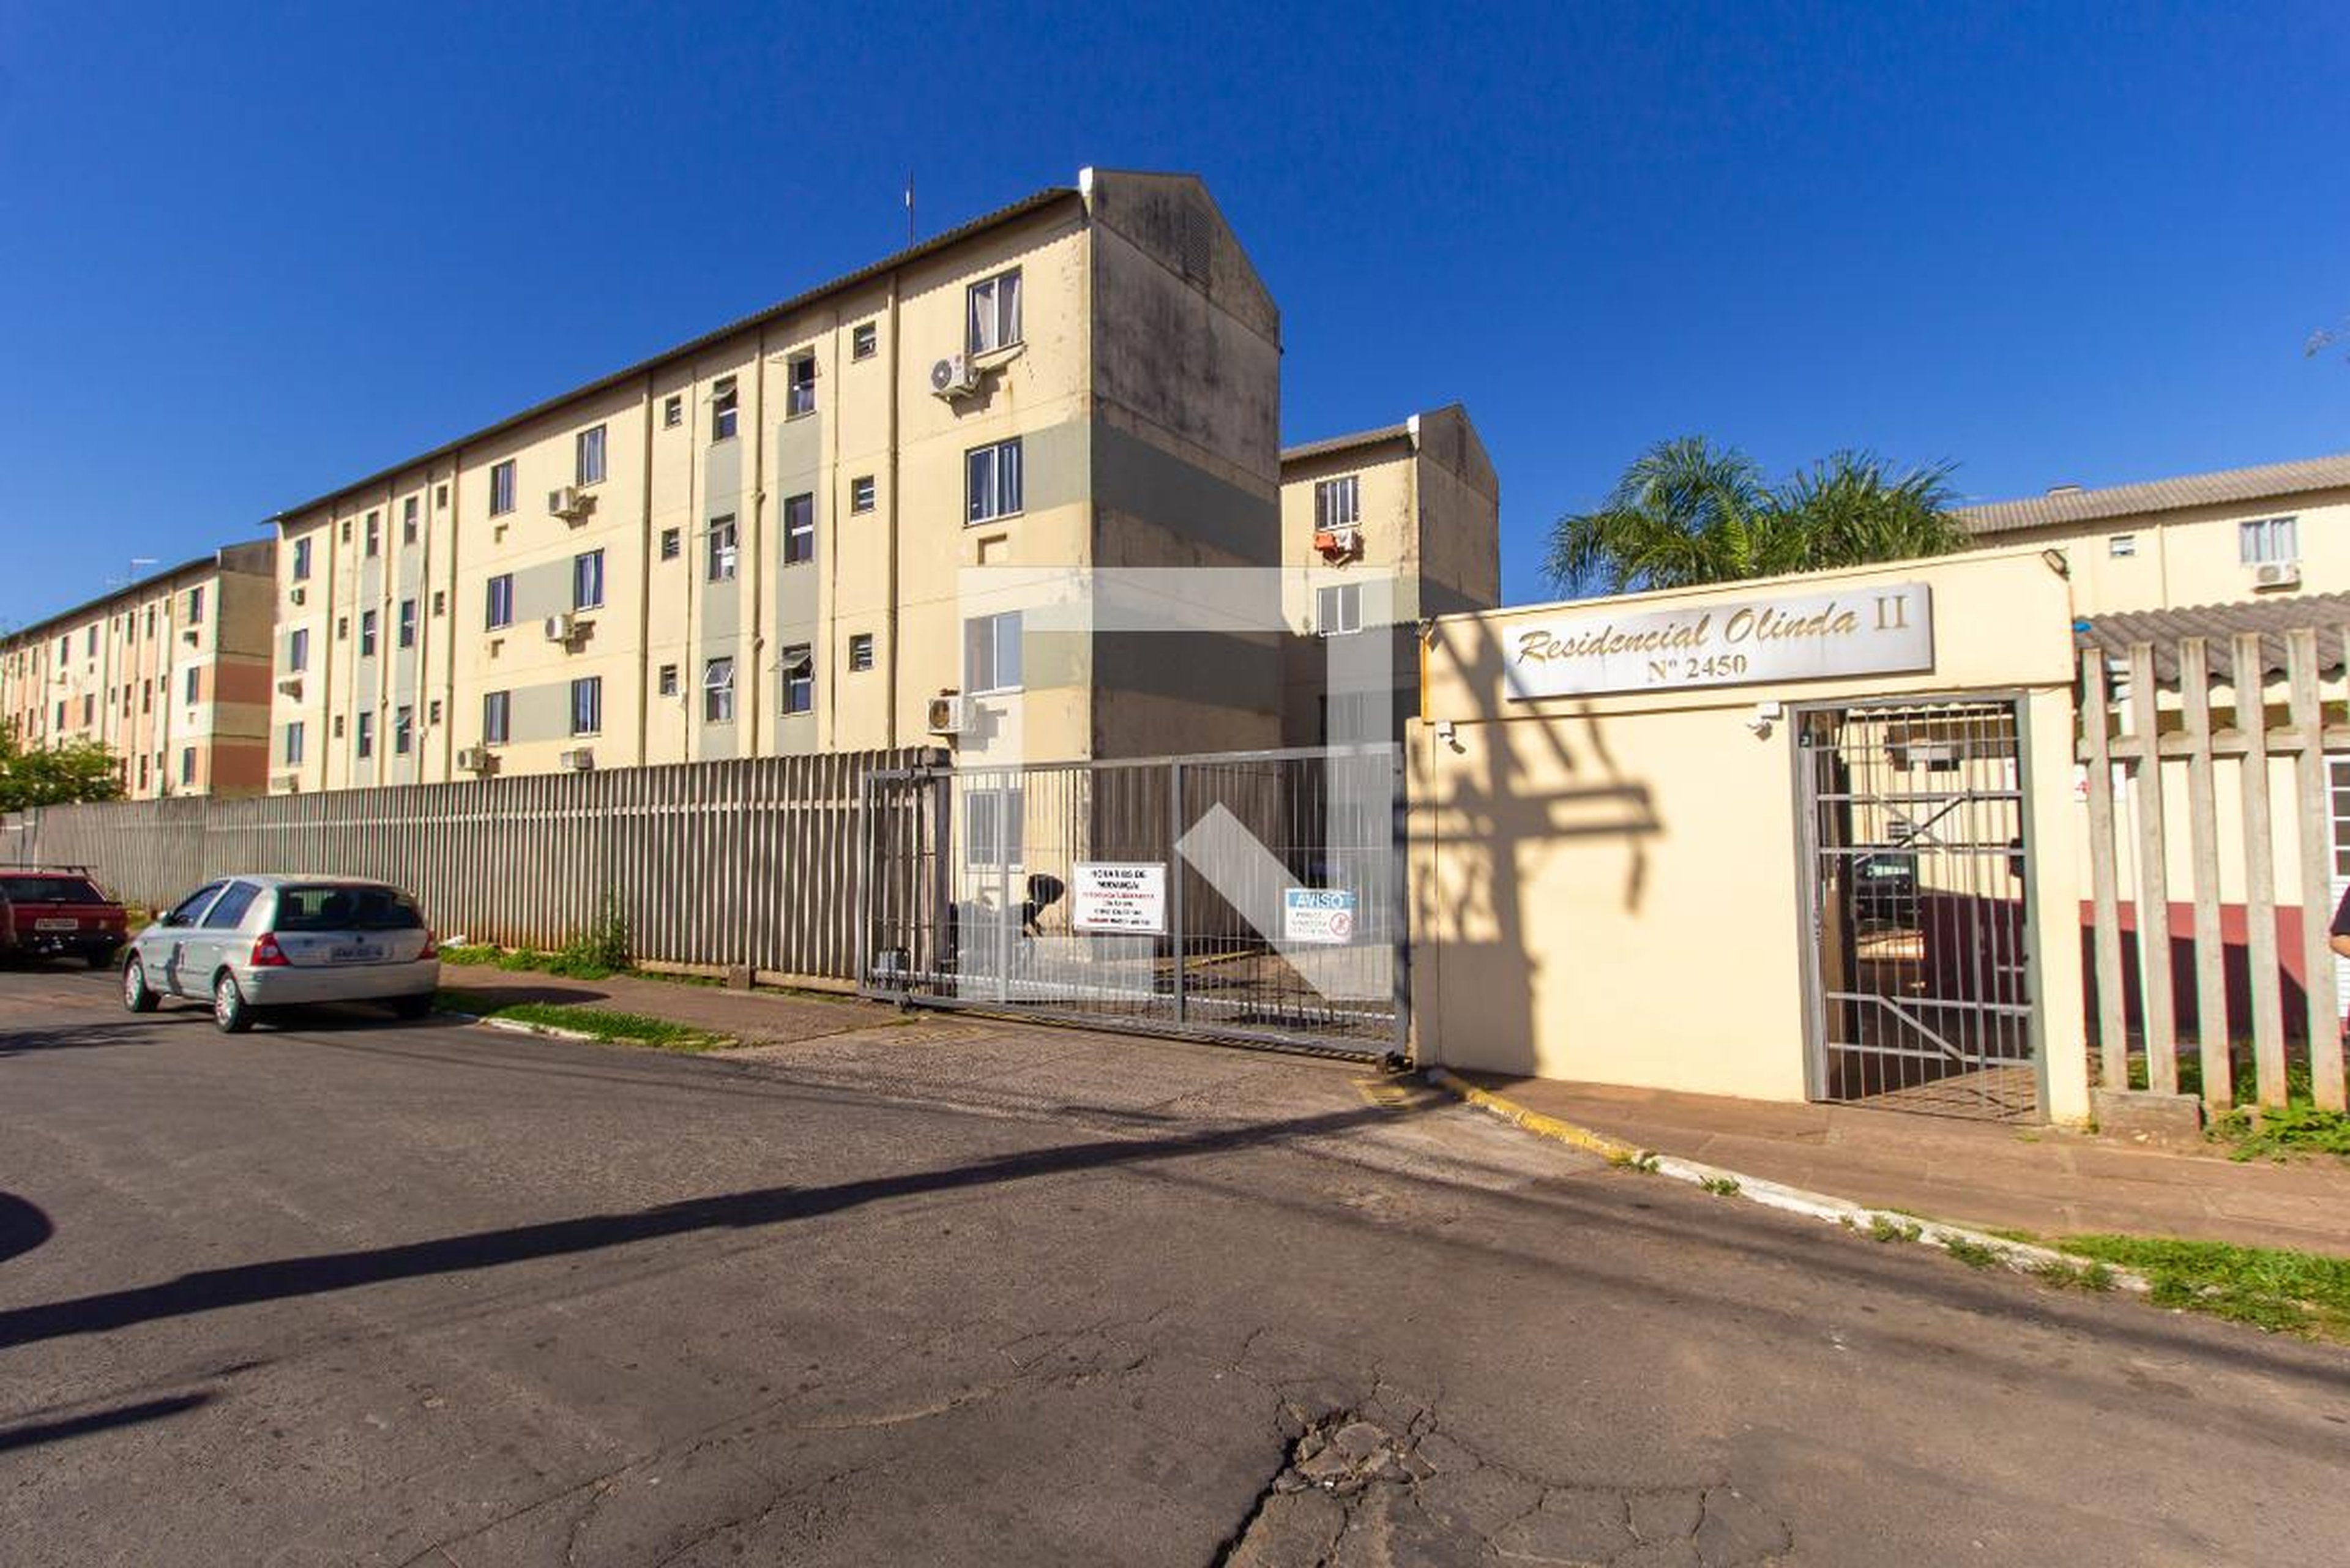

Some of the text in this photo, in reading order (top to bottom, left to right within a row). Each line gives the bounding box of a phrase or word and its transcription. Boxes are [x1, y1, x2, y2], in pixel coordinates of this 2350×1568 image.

[1516, 595, 1909, 665] Residencial Olinda II
[1686, 655, 1747, 679] 2450
[1296, 894, 1344, 908] AVISO
